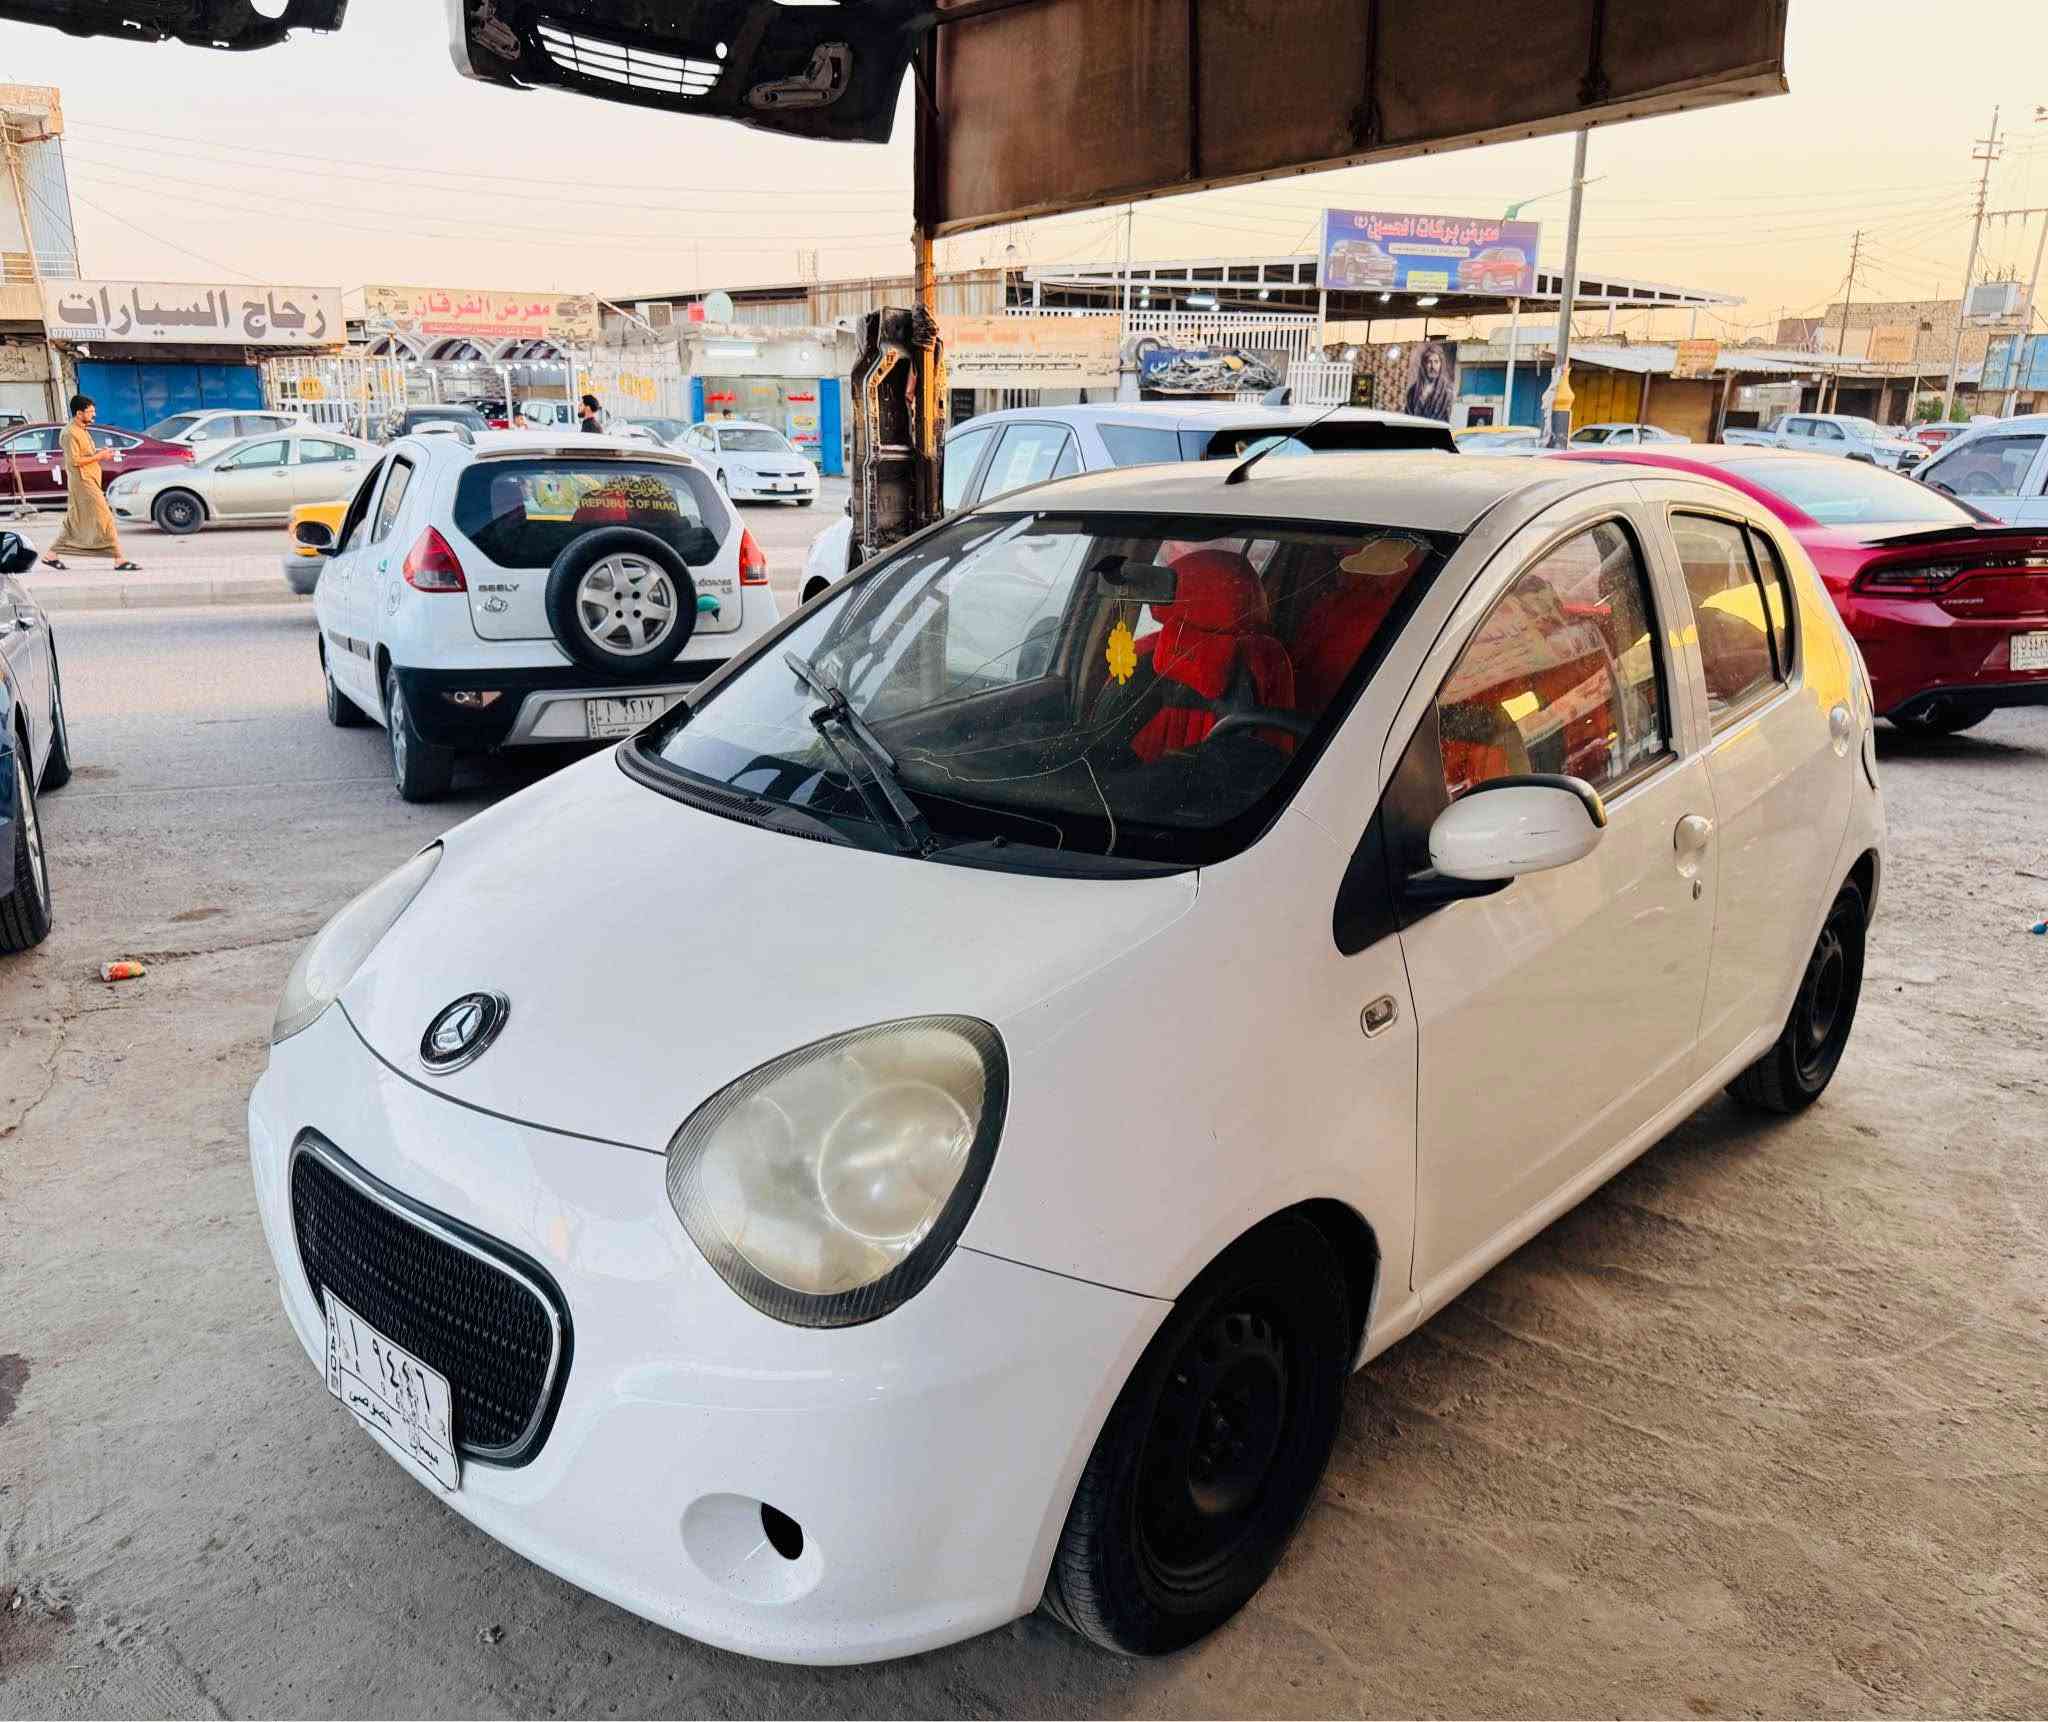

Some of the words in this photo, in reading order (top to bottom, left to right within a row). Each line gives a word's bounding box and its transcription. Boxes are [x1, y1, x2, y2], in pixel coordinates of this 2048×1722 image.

[57, 286, 230, 336] السيارات
[242, 293, 327, 339] زجاج
[413, 291, 491, 319] الفرقان
[496, 298, 552, 321] معرض
[581, 498, 634, 511] REPUBLIC
[636, 499, 651, 510] OF
[653, 500, 678, 512] IRAQ
